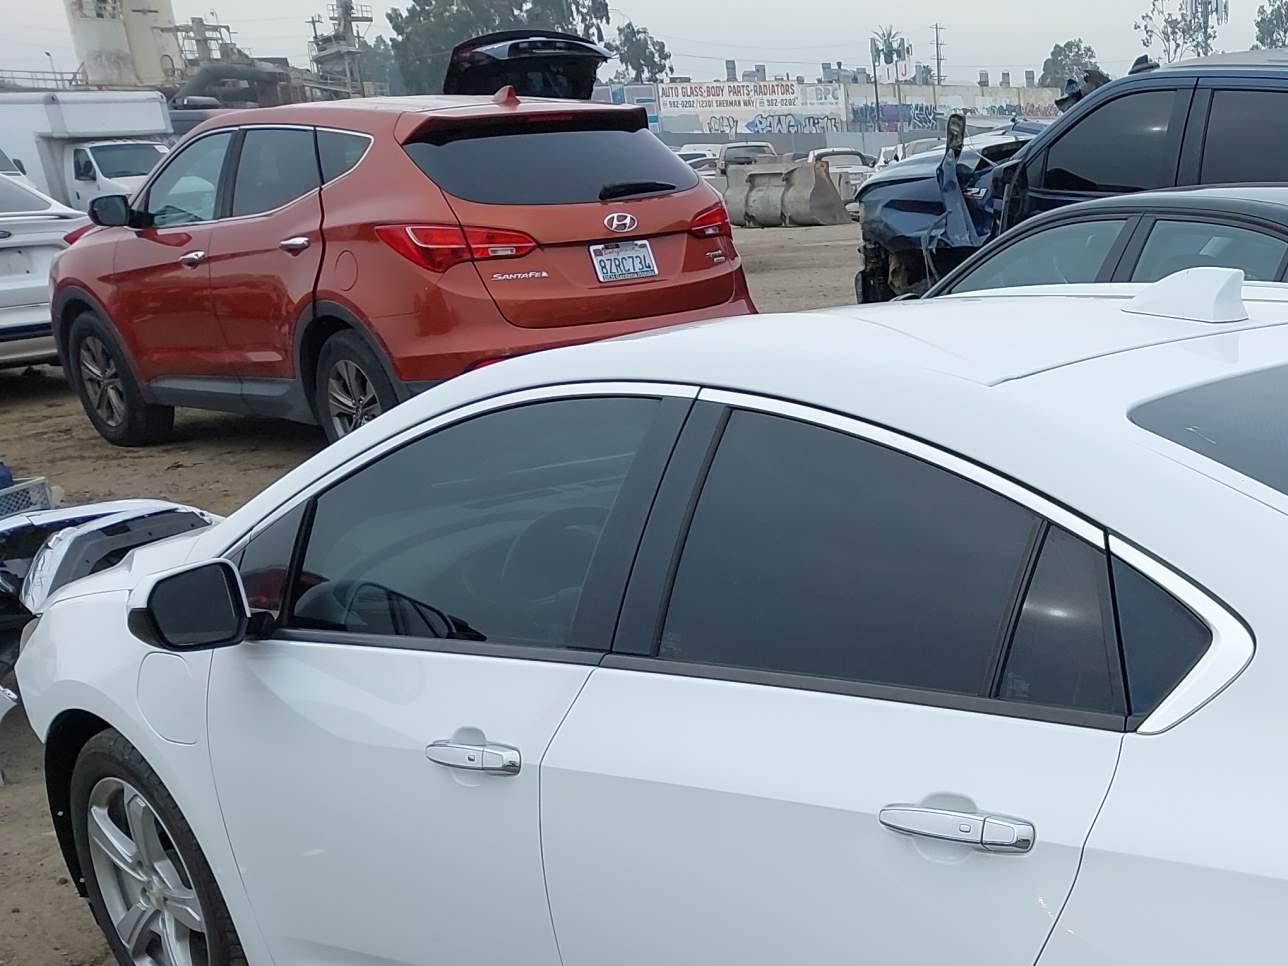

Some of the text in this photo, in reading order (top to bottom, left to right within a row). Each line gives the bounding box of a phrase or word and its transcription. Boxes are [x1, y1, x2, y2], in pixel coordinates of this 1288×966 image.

[661, 86, 679, 98] AUTO
[715, 99, 742, 108] SHERMAN
[743, 99, 754, 107] WAY
[599, 254, 652, 275] 8ZRC734
